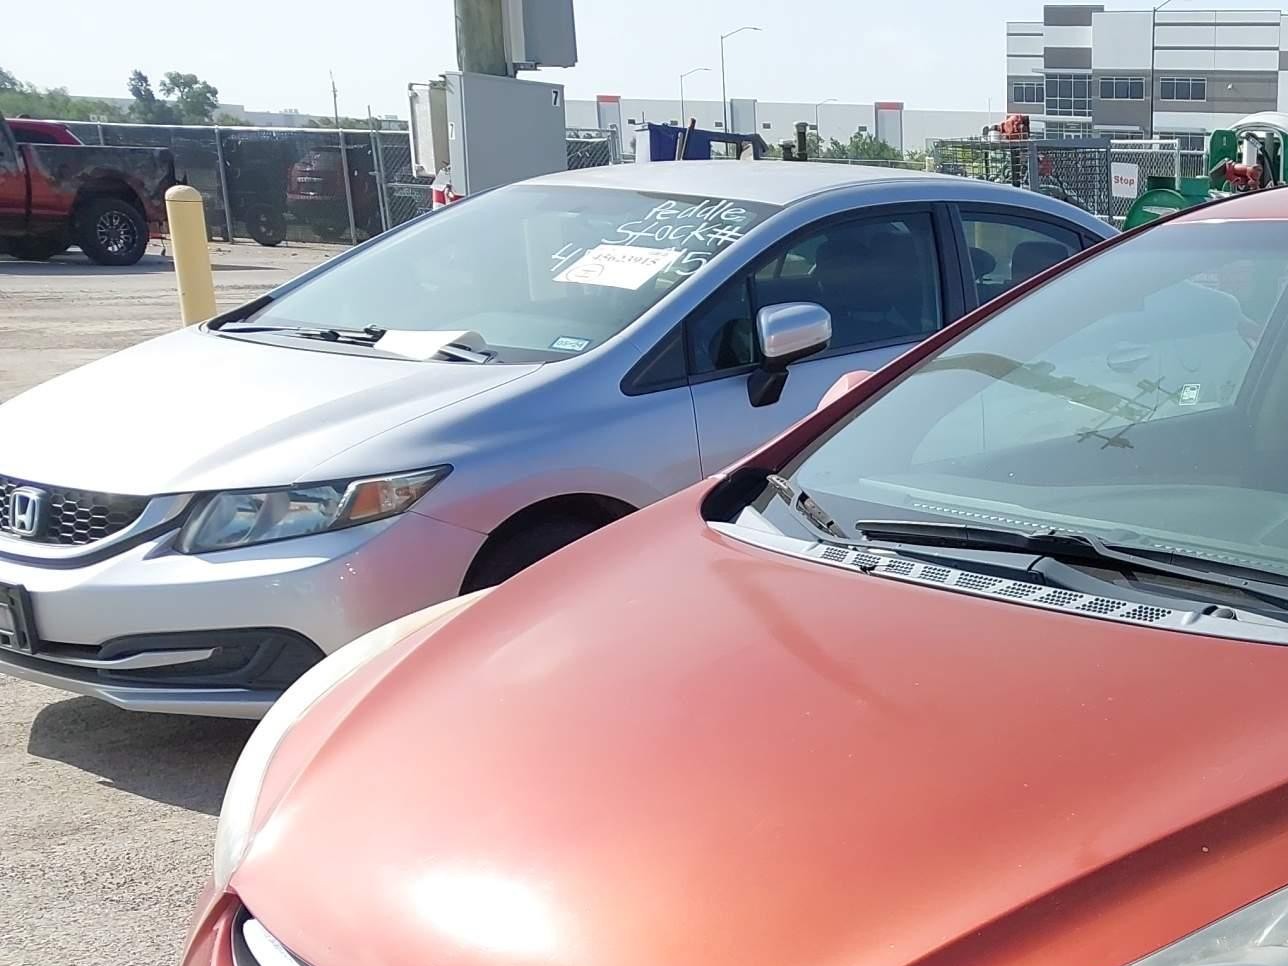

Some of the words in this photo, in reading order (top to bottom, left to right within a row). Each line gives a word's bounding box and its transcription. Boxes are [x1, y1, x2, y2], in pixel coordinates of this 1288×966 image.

[552, 90, 559, 106] 7
[1113, 175, 1135, 187] Stop
[644, 199, 747, 222] Peddle
